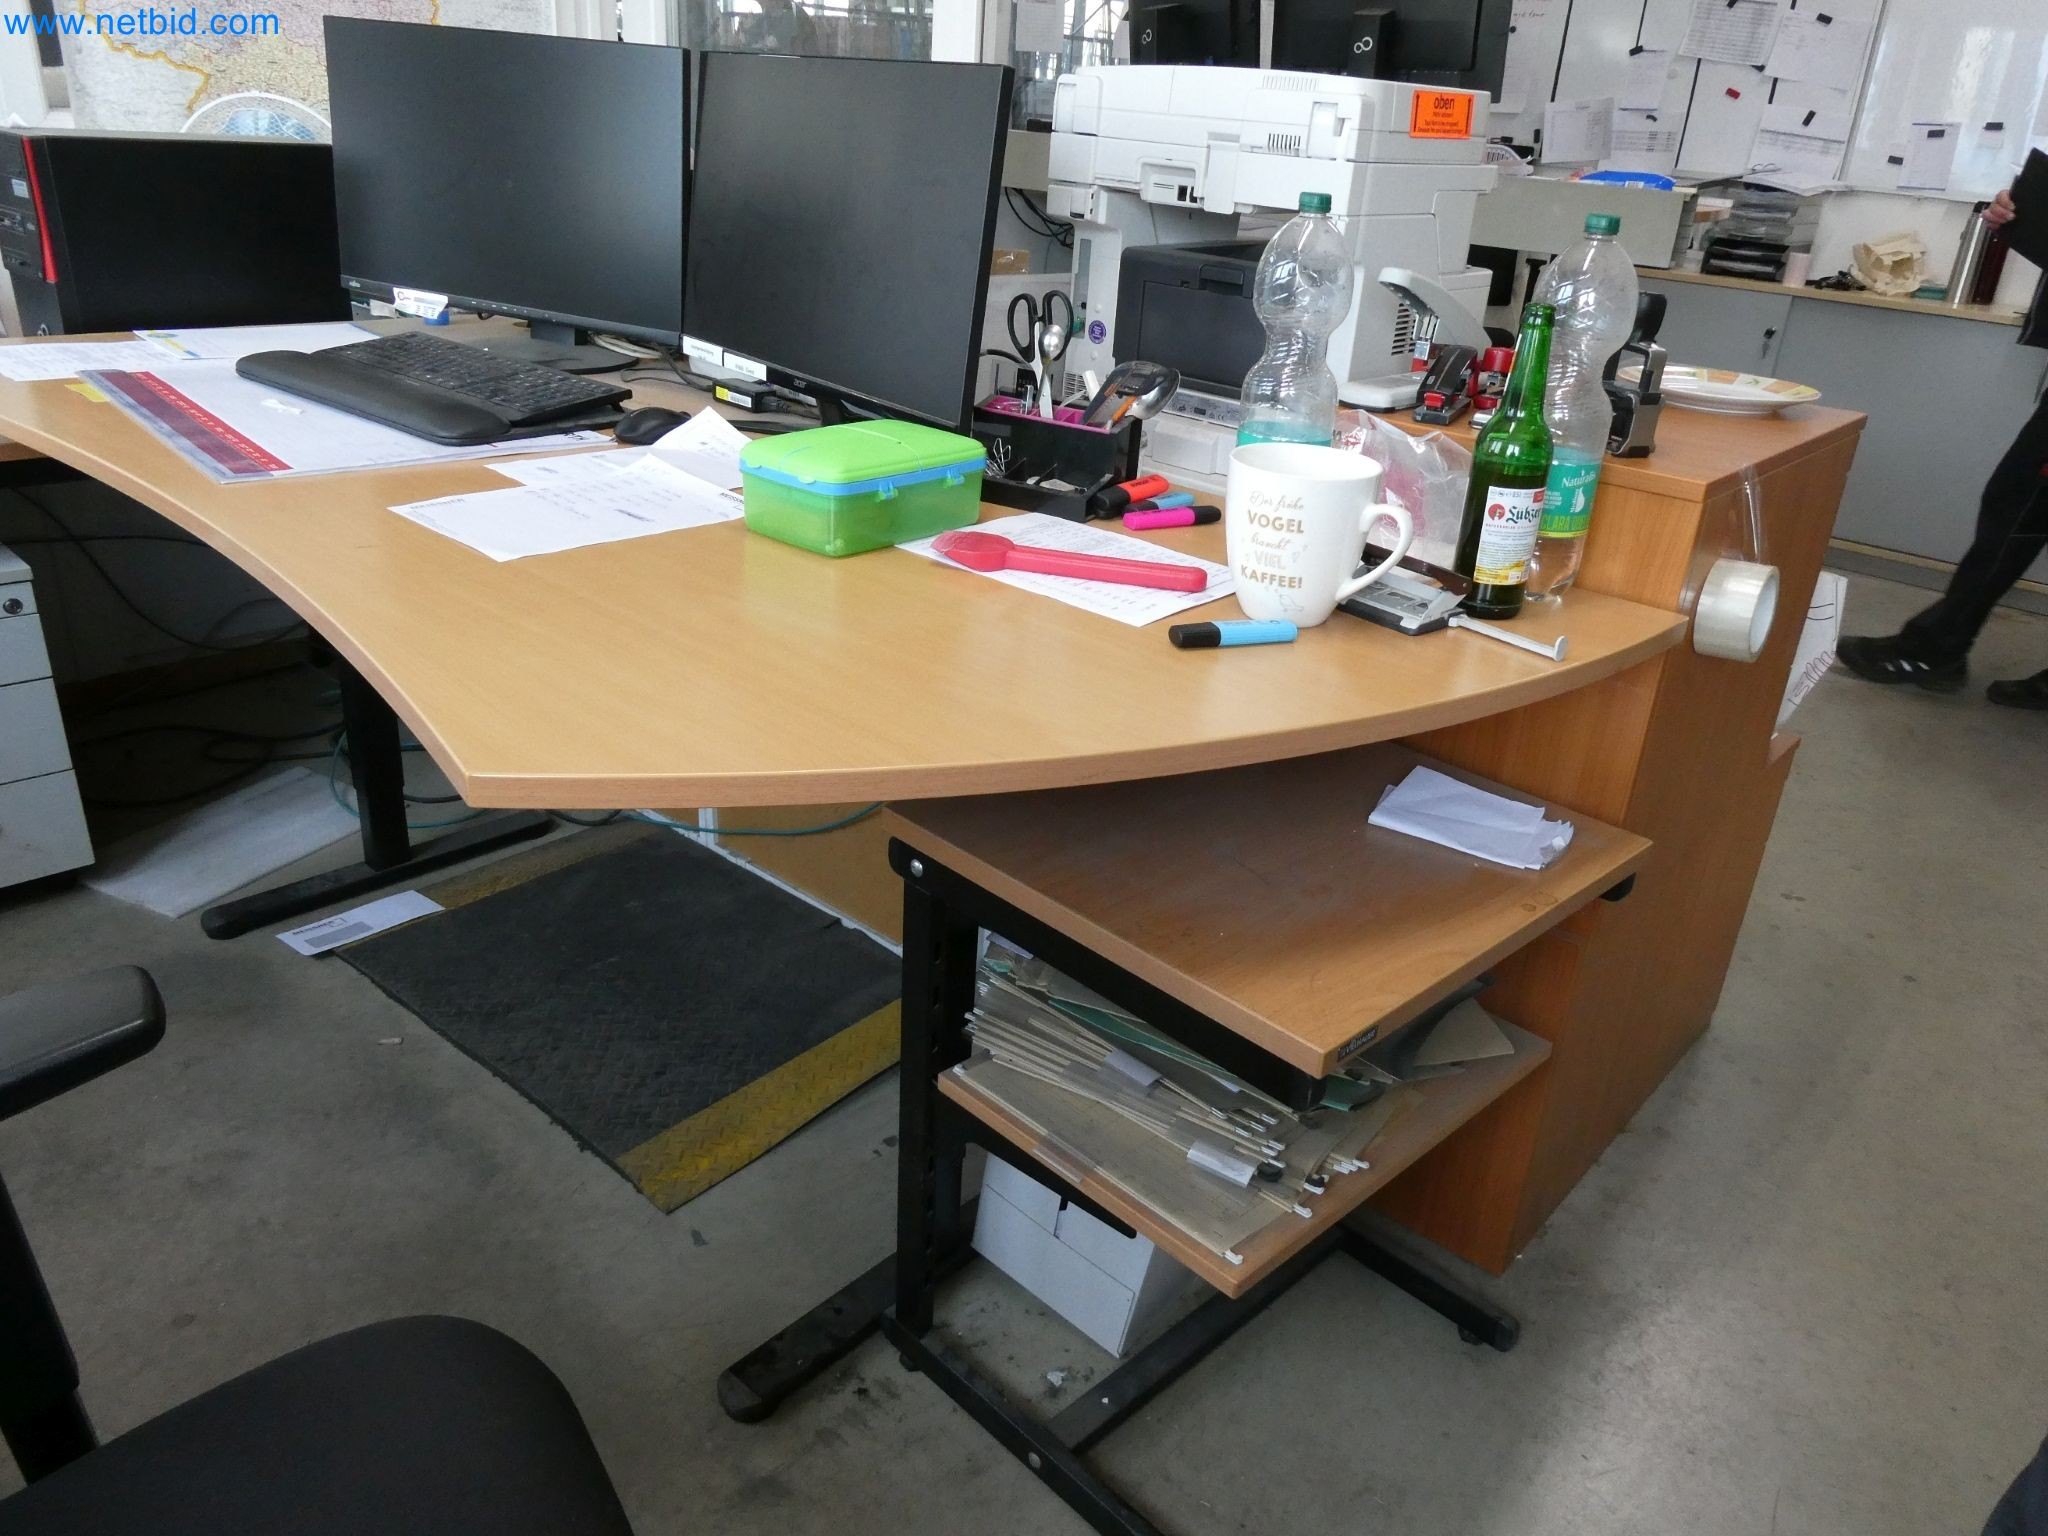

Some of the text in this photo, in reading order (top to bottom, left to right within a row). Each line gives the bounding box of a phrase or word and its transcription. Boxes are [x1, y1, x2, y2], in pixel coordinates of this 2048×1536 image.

[1433, 92, 1455, 110] oben
[1248, 509, 1304, 534] VOGEL
[1254, 551, 1287, 570] VIEL
[1241, 564, 1303, 590] KAFFEE!
